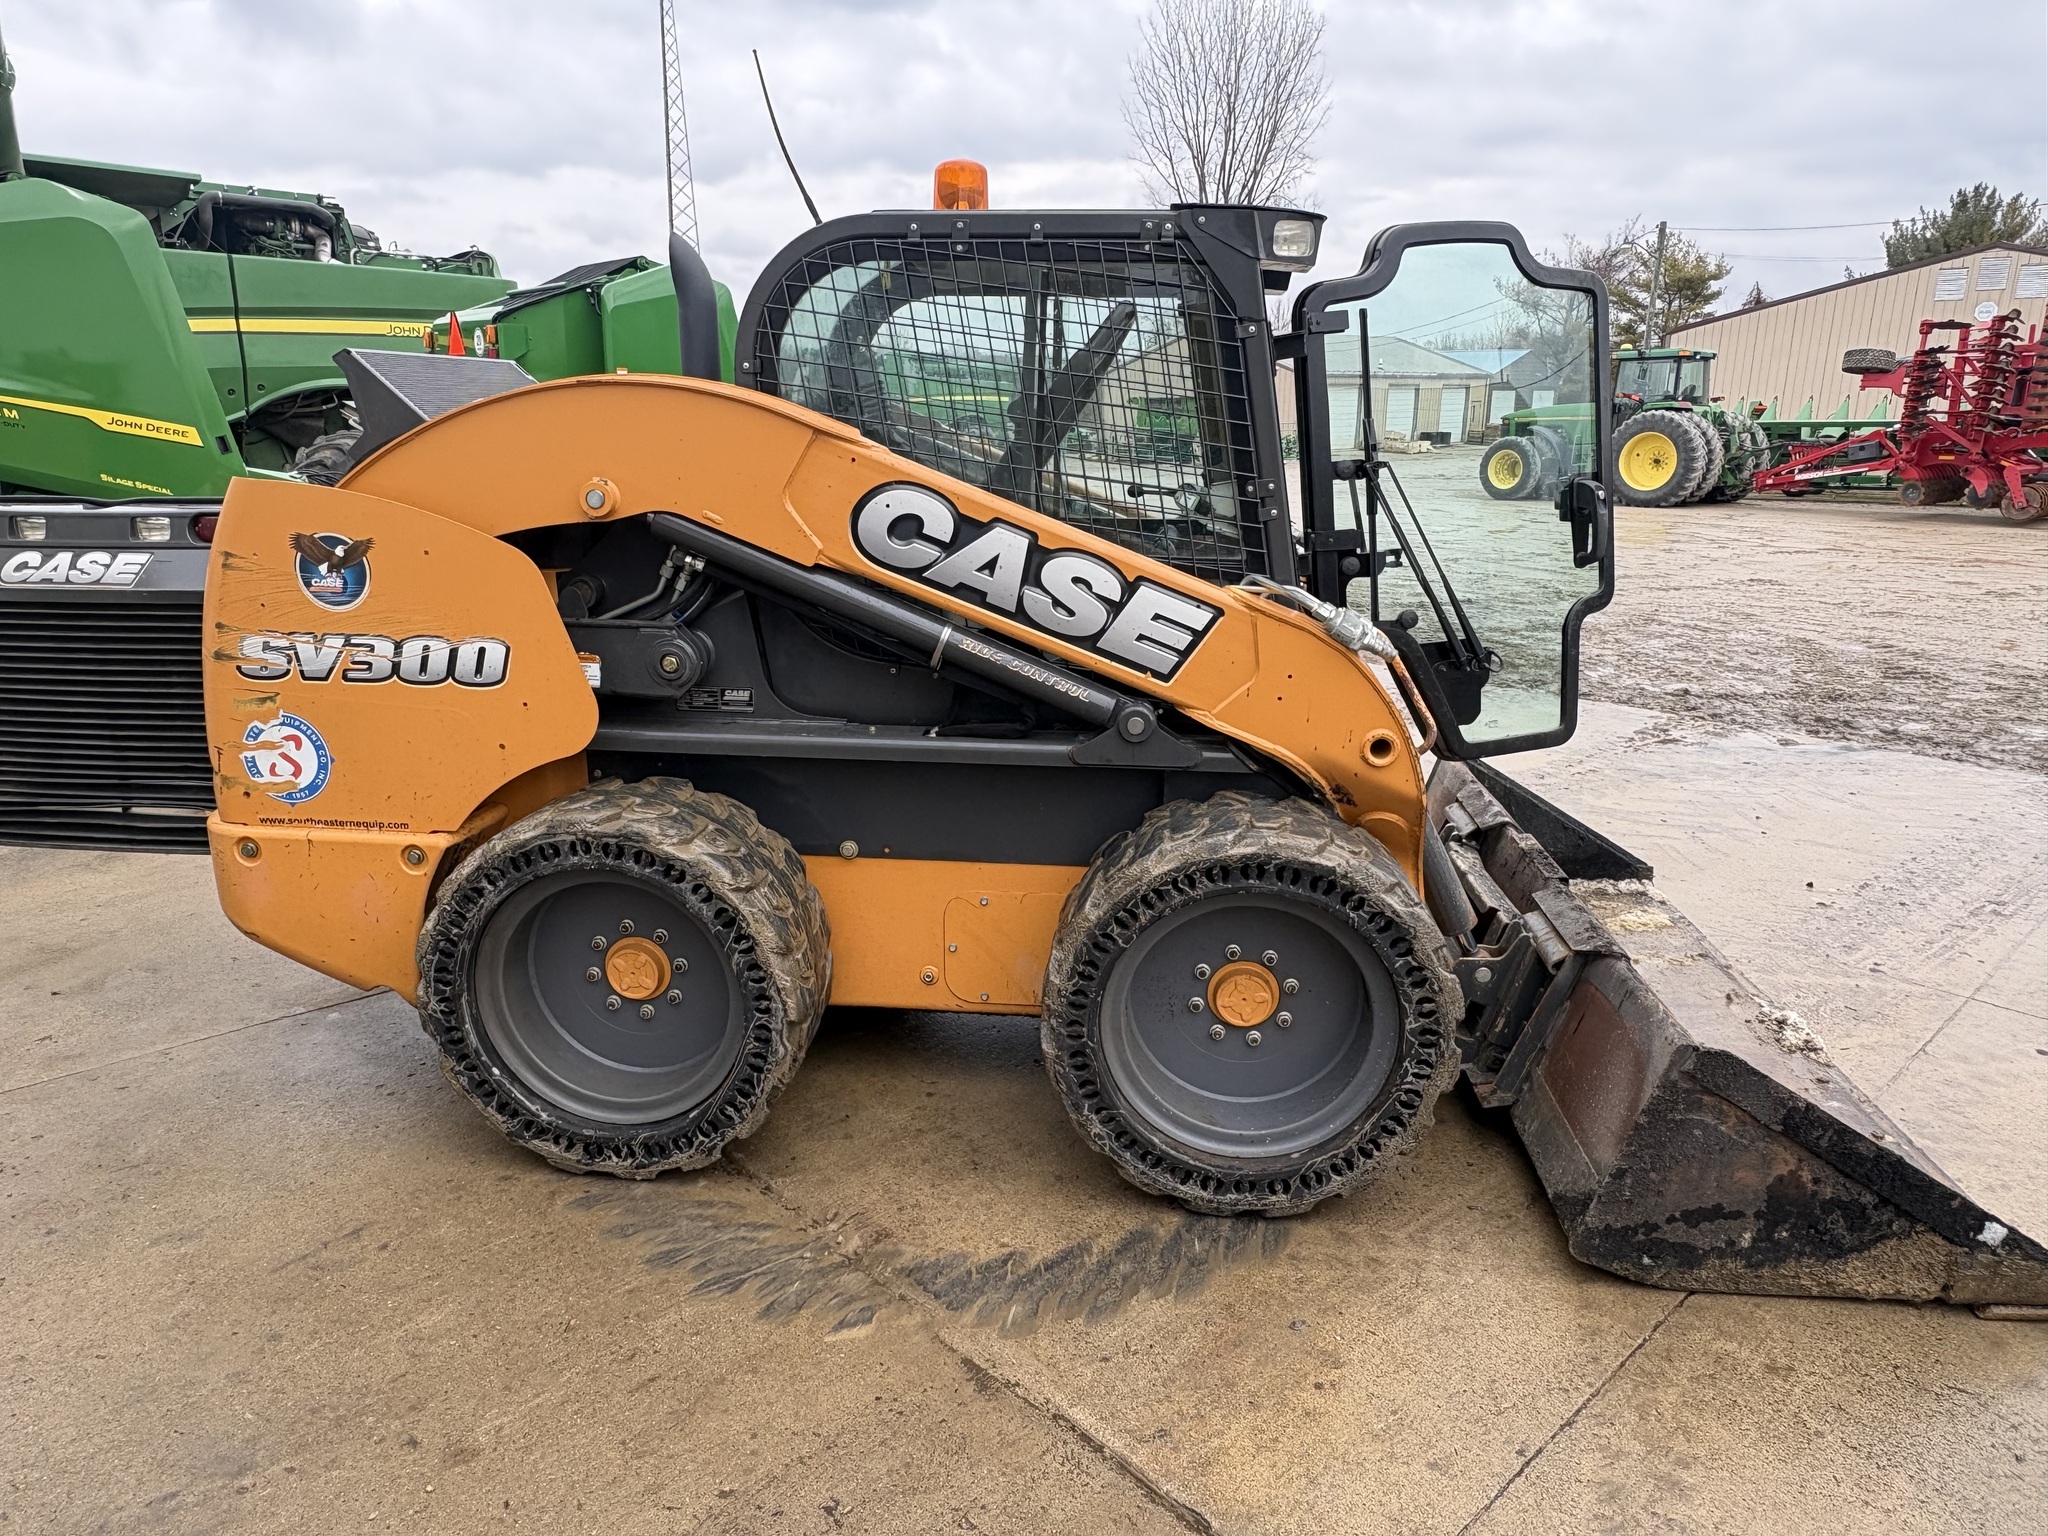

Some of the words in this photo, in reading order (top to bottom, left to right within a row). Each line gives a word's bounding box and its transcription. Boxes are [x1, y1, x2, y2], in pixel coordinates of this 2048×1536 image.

[385, 324, 421, 337] JOHN
[106, 417, 143, 431] JOHN
[145, 423, 189, 438] DEERE
[100, 473, 134, 487] SILAGE
[135, 481, 174, 495] SPECIAL
[0, 551, 153, 583] CASE
[311, 578, 344, 588] CASE
[850, 480, 1224, 684] CASE
[236, 634, 511, 690] SV300
[724, 689, 751, 698] CASE
[280, 716, 322, 746] UIPMENT
